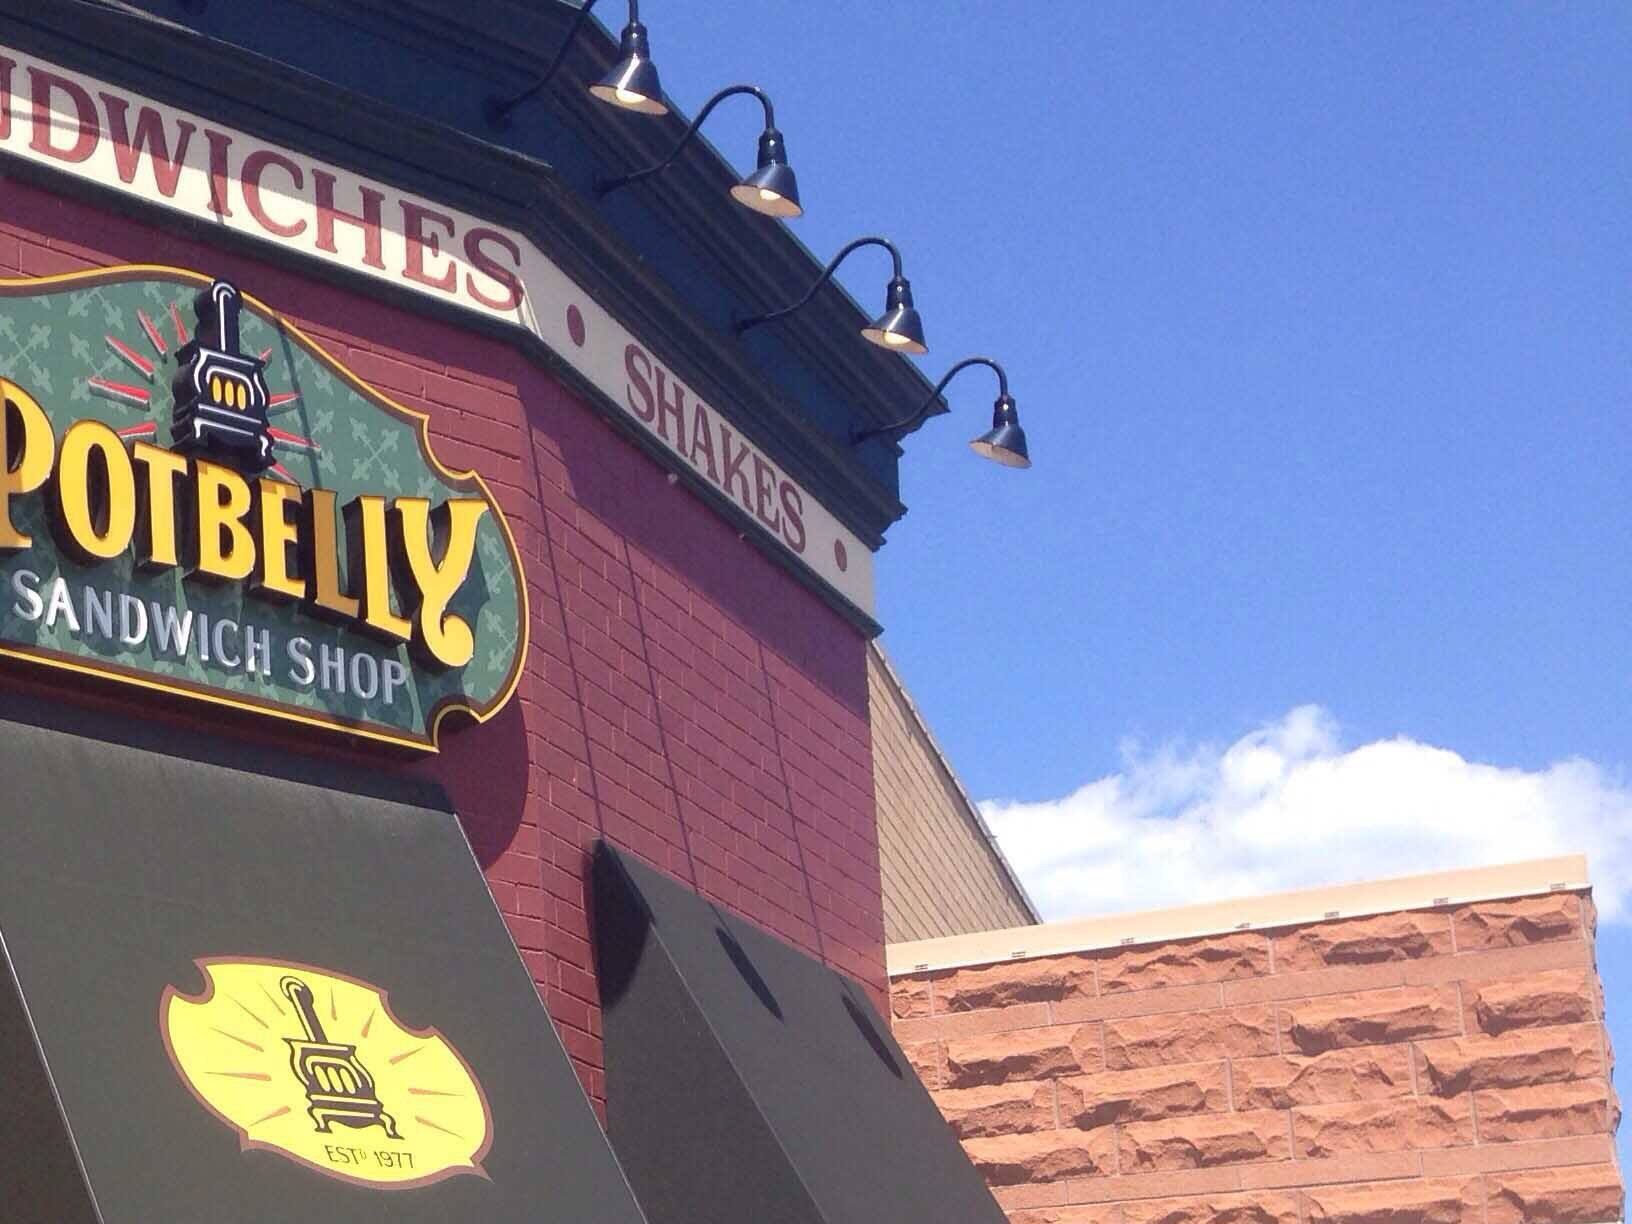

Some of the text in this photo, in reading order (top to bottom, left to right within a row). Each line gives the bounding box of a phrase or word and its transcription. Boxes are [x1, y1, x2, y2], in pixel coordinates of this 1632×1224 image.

[624, 343, 806, 554] SHAKES
[11, 570, 408, 703] SANDWICH SHOP
[373, 1151, 413, 1168] 1977
